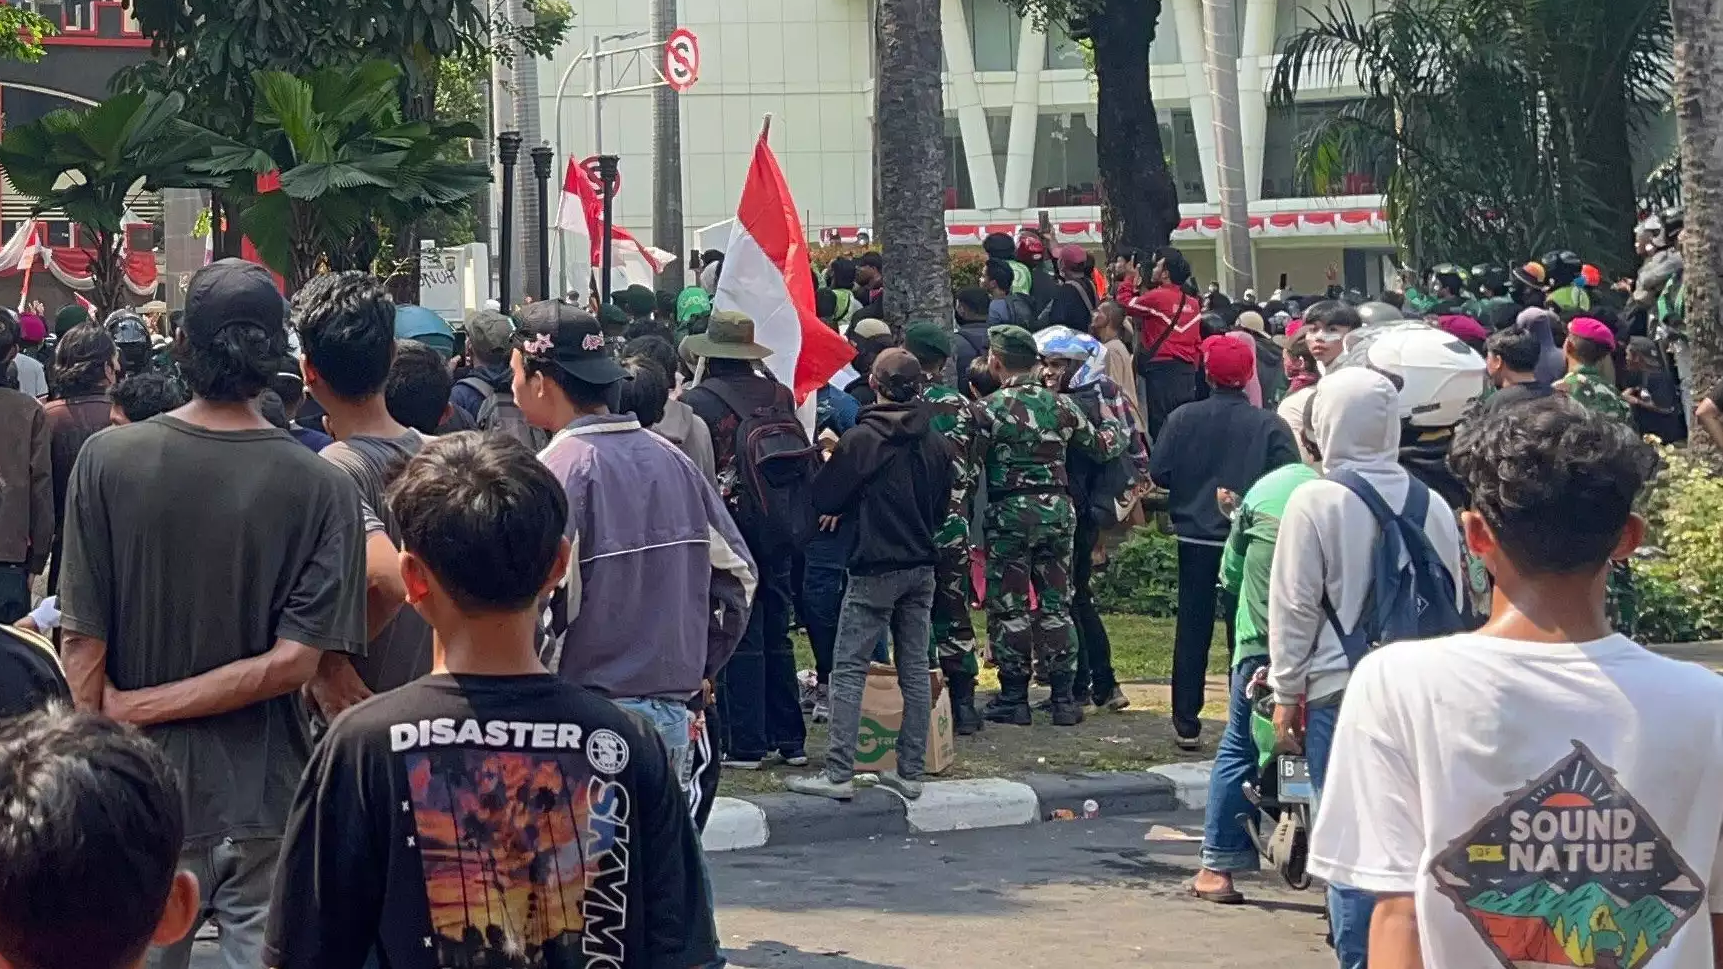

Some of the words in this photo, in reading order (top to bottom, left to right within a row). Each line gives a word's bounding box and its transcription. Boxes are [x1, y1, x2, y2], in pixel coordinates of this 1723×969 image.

[390, 718, 583, 752] DISASTER
[1285, 760, 1295, 777] B
[1509, 808, 1636, 843] SOUND
[1509, 841, 1656, 873] NATURE
